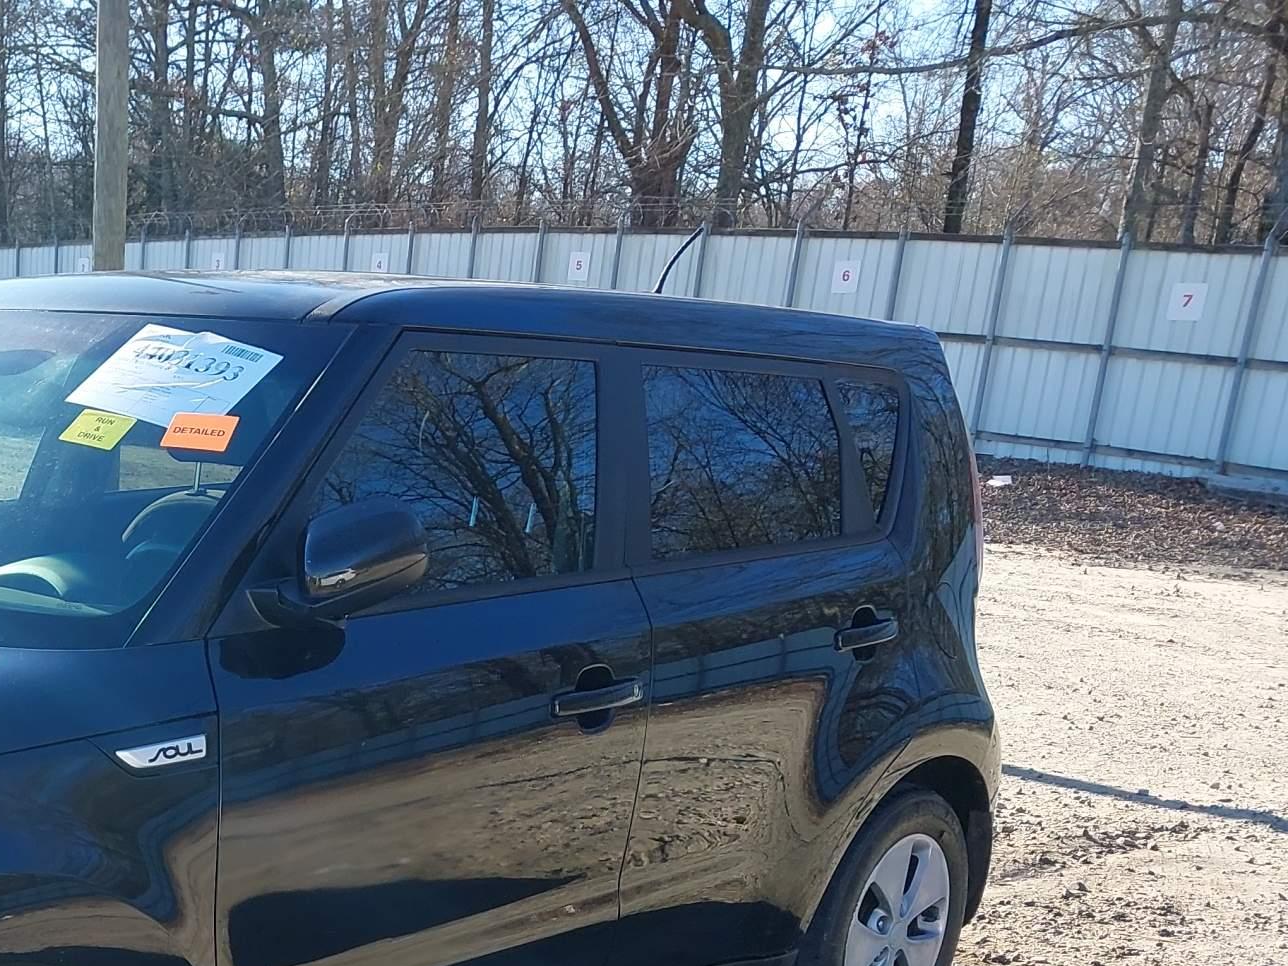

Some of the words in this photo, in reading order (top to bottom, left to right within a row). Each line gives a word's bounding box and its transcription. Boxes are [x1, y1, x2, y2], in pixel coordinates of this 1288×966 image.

[376, 260, 382, 270] 4
[575, 260, 582, 270] 5
[842, 270, 850, 282] 6
[1182, 294, 1193, 307] 7
[95, 416, 116, 426] RUN
[77, 431, 105, 442] DRIVE
[173, 426, 226, 437] DETAILED
[148, 742, 203, 763] SOUL
